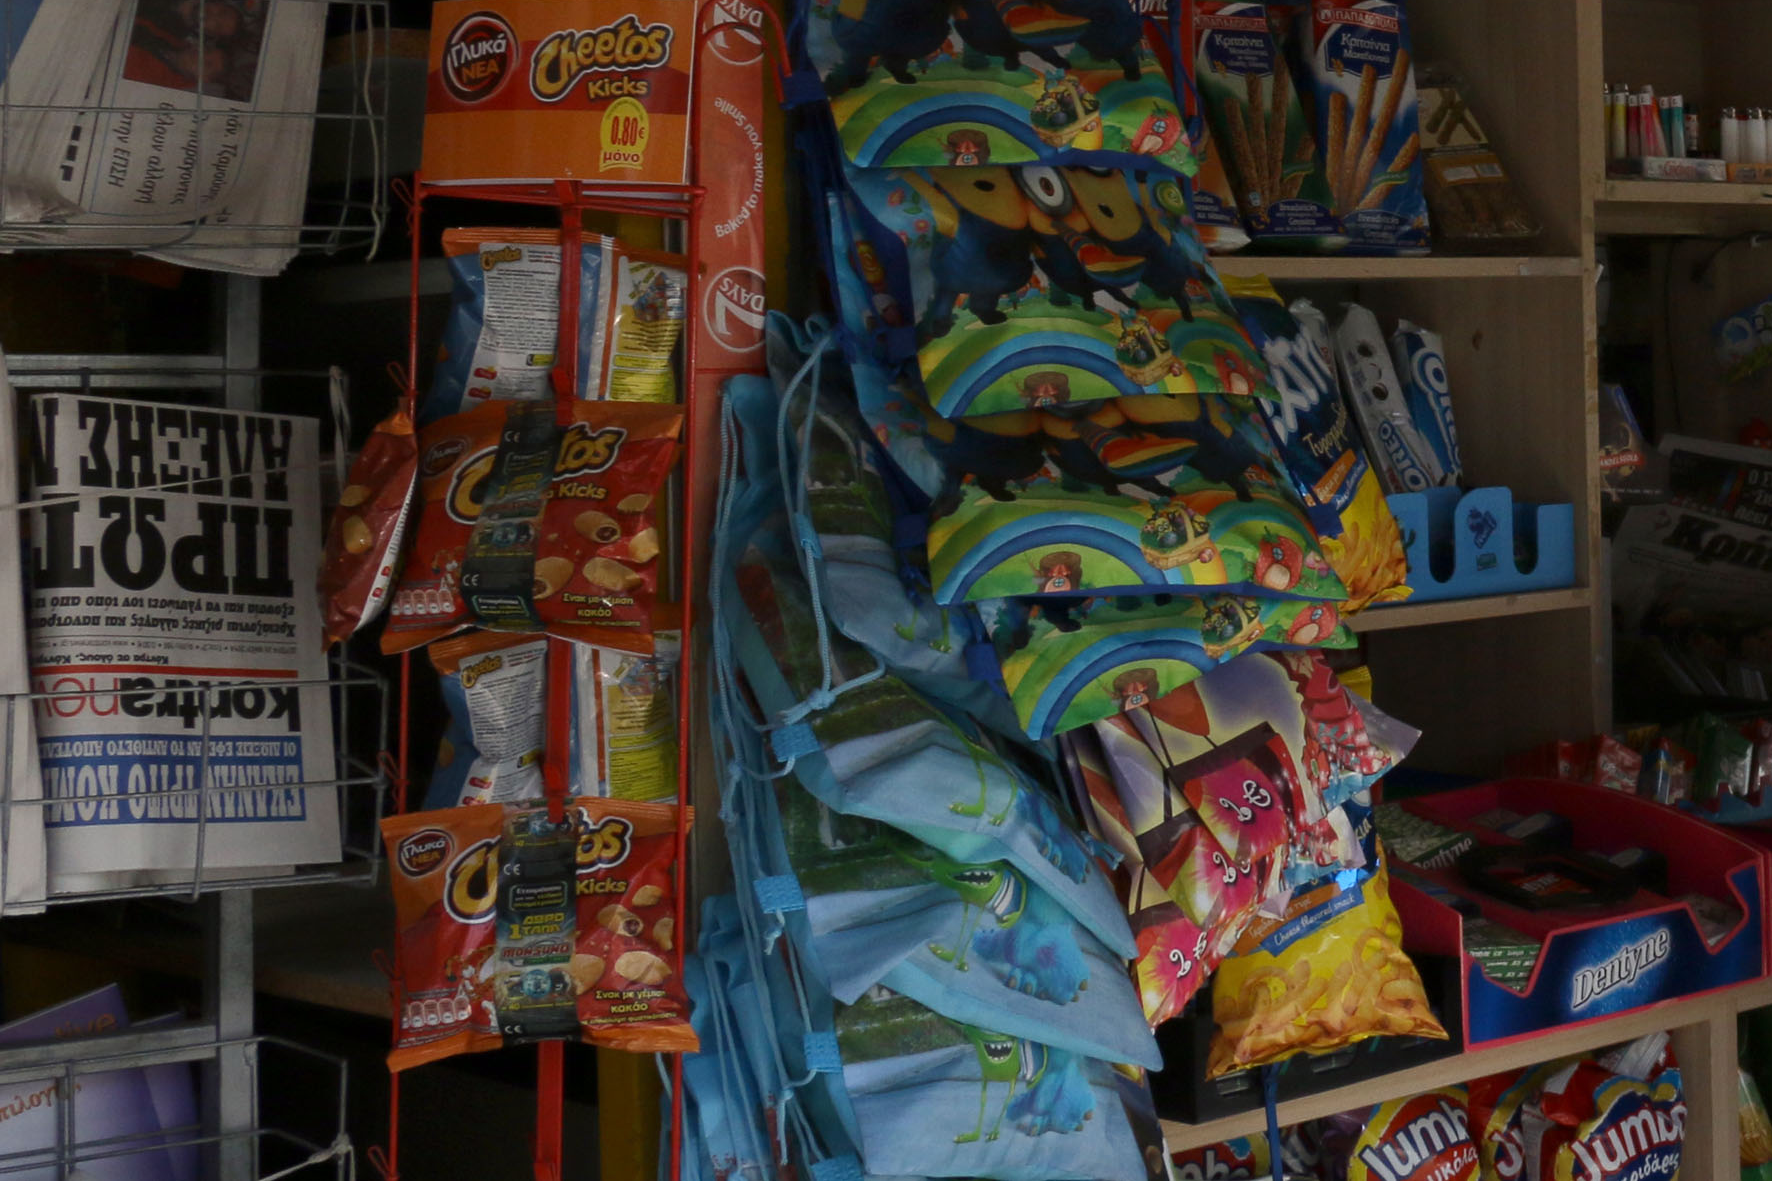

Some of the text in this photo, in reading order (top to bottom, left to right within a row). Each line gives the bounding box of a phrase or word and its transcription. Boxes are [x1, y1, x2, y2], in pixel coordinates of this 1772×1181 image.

[529, 14, 676, 105] Cheetos
[587, 76, 650, 101] Kicks
[601, 148, 643, 166] μόνο
[715, 206, 750, 238] Baked
[78, 400, 292, 502] ΑΛΕΞΗΣ
[558, 481, 607, 502] Kicks
[578, 877, 628, 895] Kicks
[1571, 927, 1671, 1012] Dentyne
